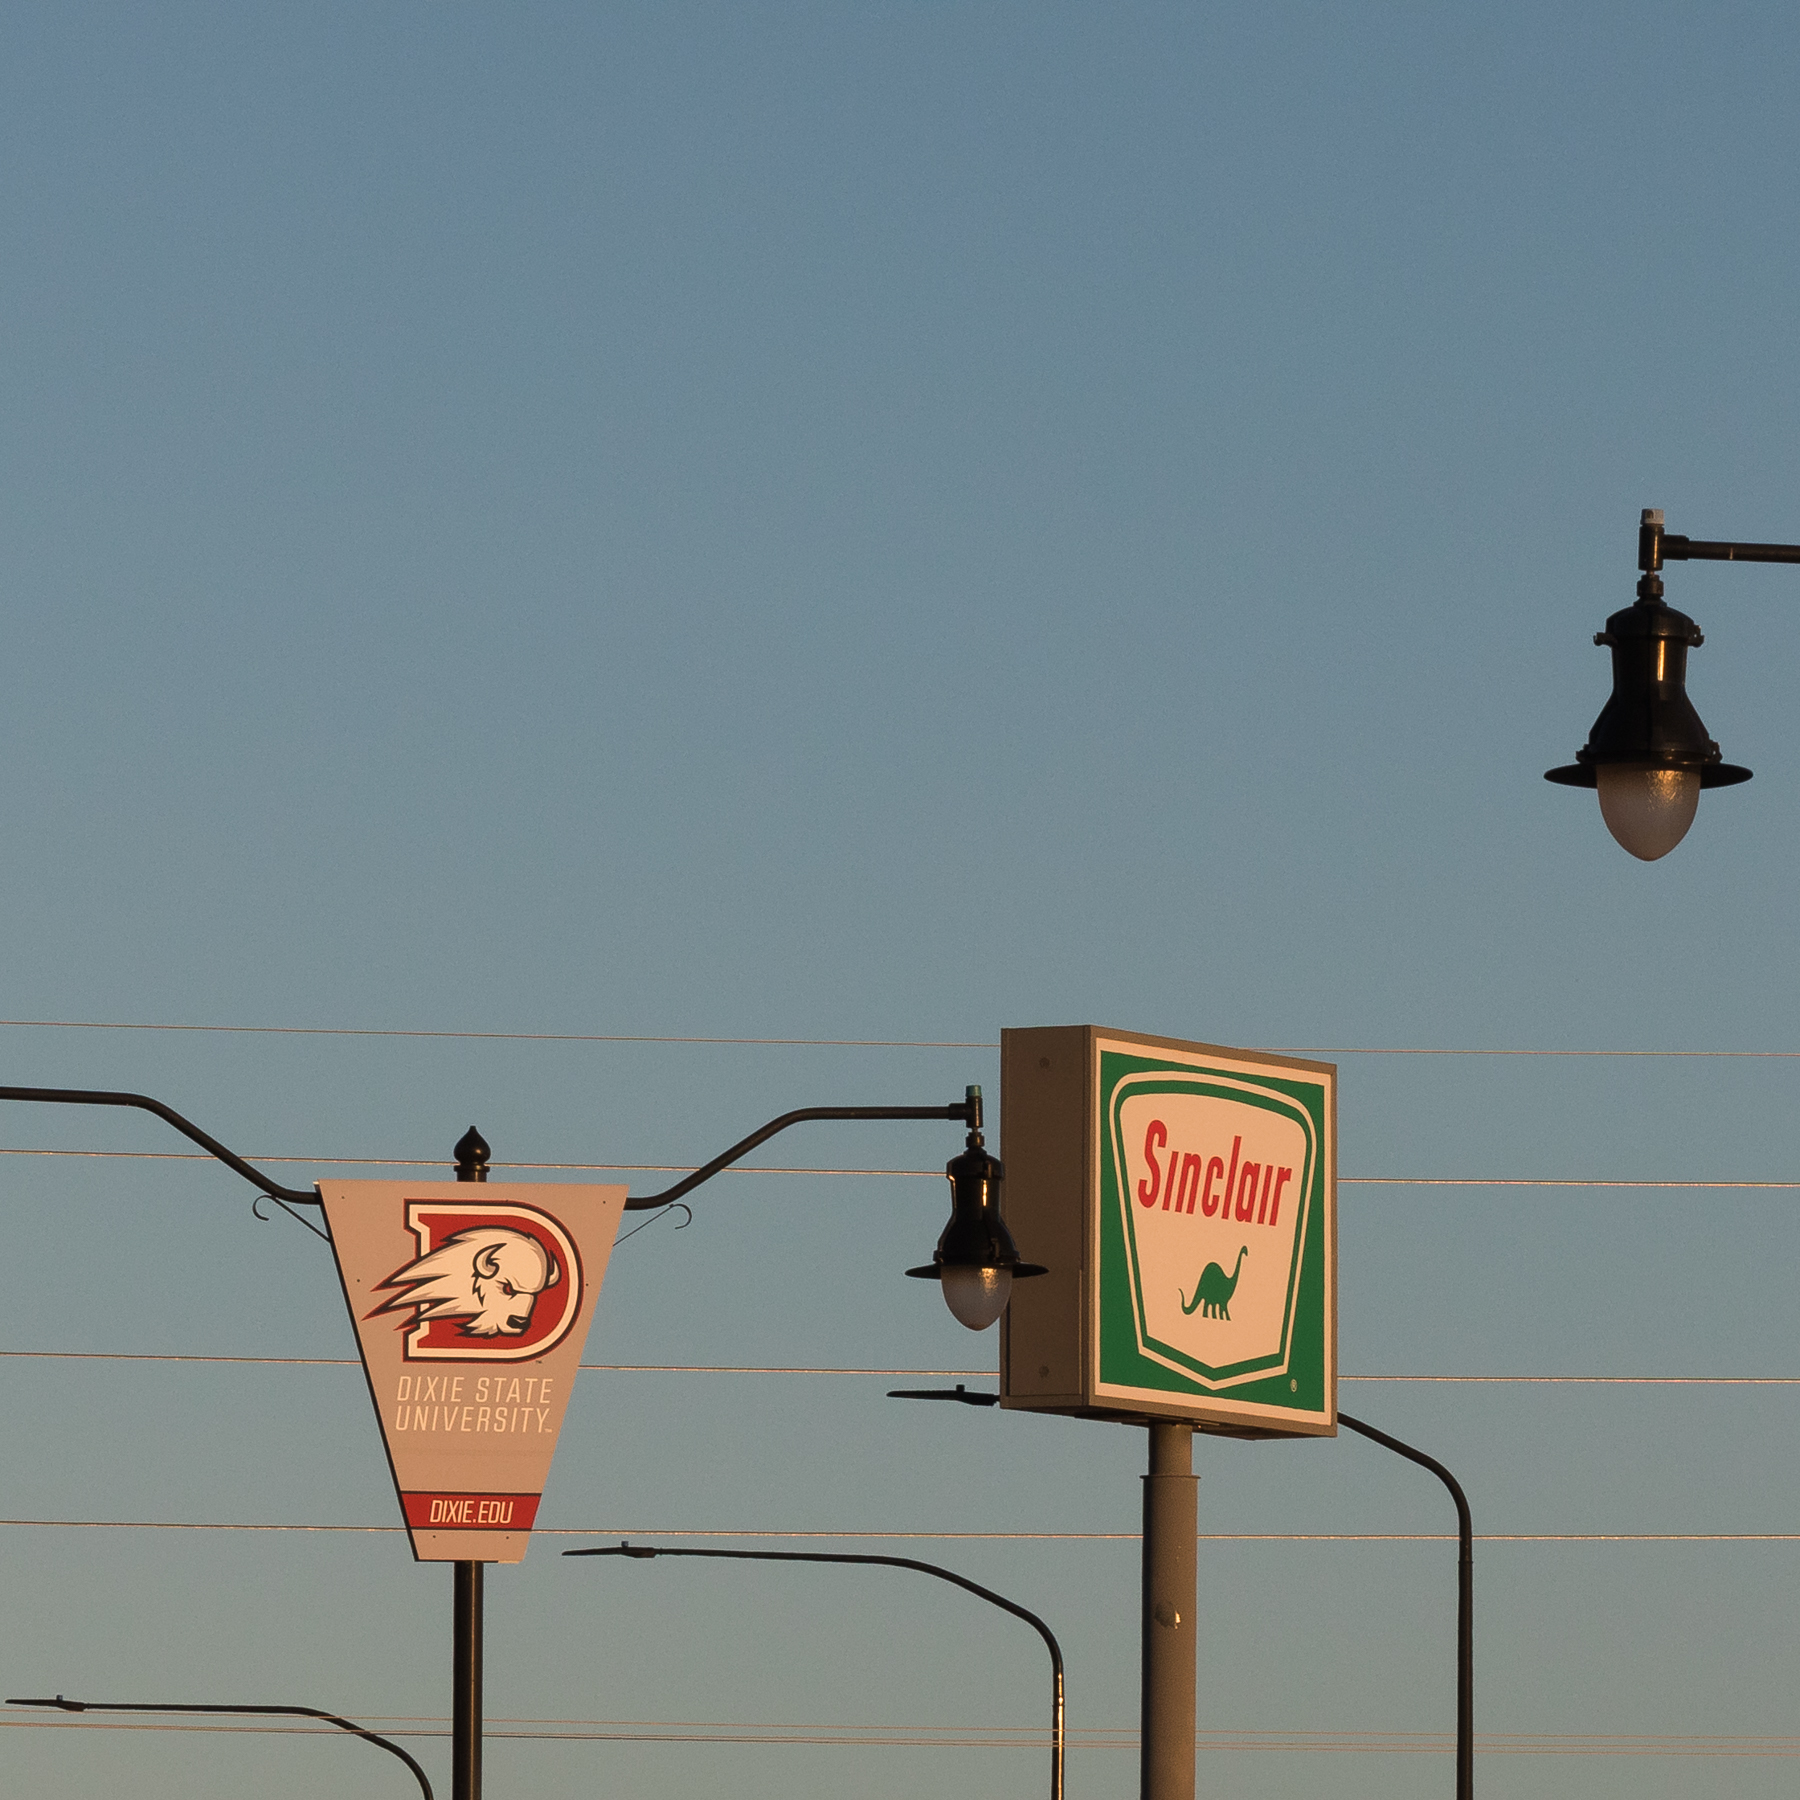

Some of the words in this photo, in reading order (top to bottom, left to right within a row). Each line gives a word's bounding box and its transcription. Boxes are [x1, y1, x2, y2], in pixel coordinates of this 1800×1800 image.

[1137, 1119, 1292, 1227] Sinclair
[397, 1376, 465, 1402] DIXIE
[475, 1377, 554, 1404] STATE
[394, 1405, 551, 1433] UNIVERSITY
[429, 1499, 513, 1525] DIXIE.EDU
